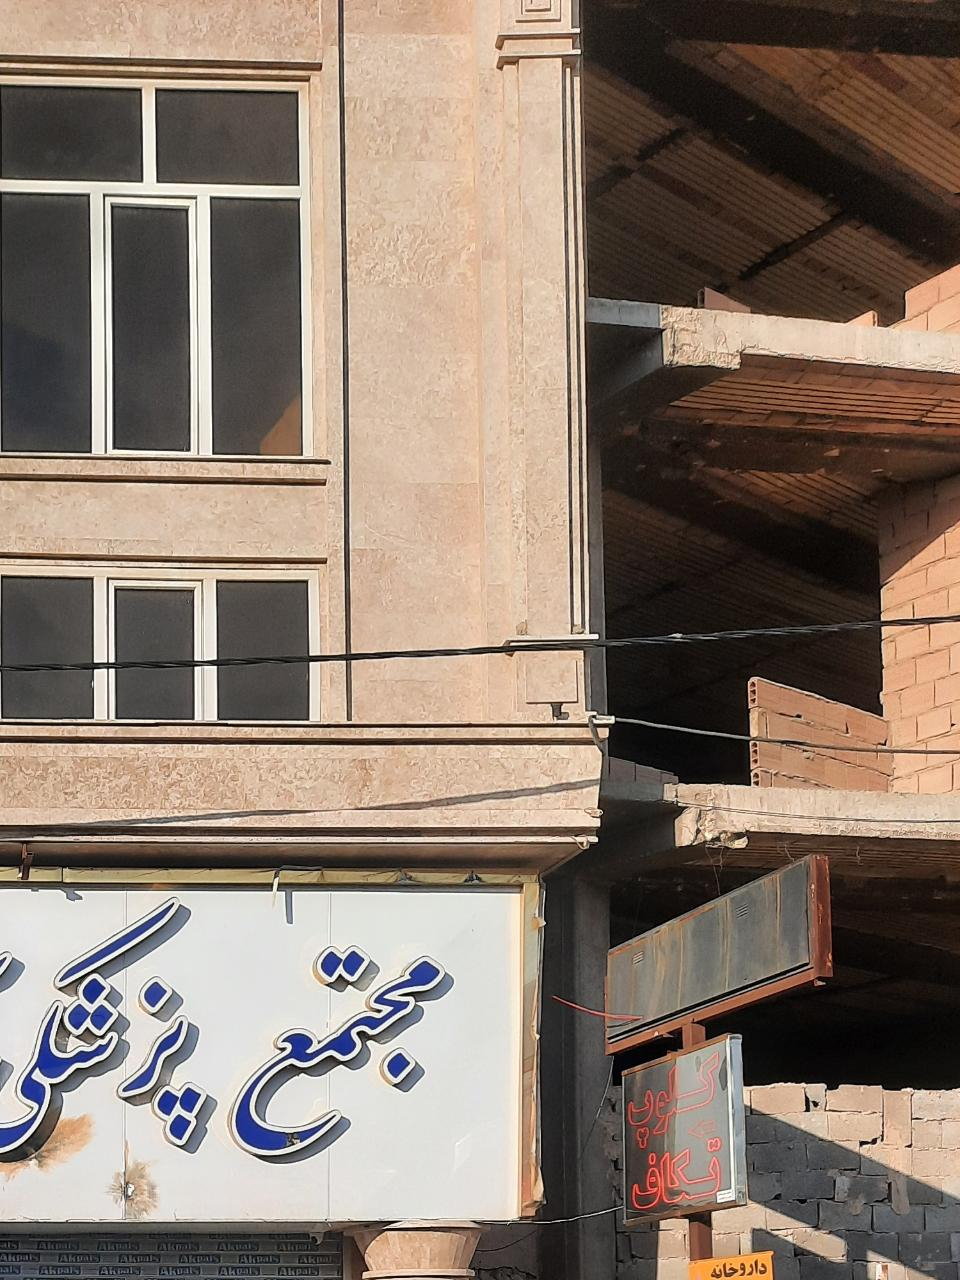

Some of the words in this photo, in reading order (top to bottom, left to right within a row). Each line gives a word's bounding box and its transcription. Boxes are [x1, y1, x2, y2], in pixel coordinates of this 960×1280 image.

[233, 945, 445, 1155] مجتمع
[628, 1051, 719, 1149] کلوپ
[631, 1138, 721, 1209] تکاف
[711, 1259, 767, 1278] داروخانه
